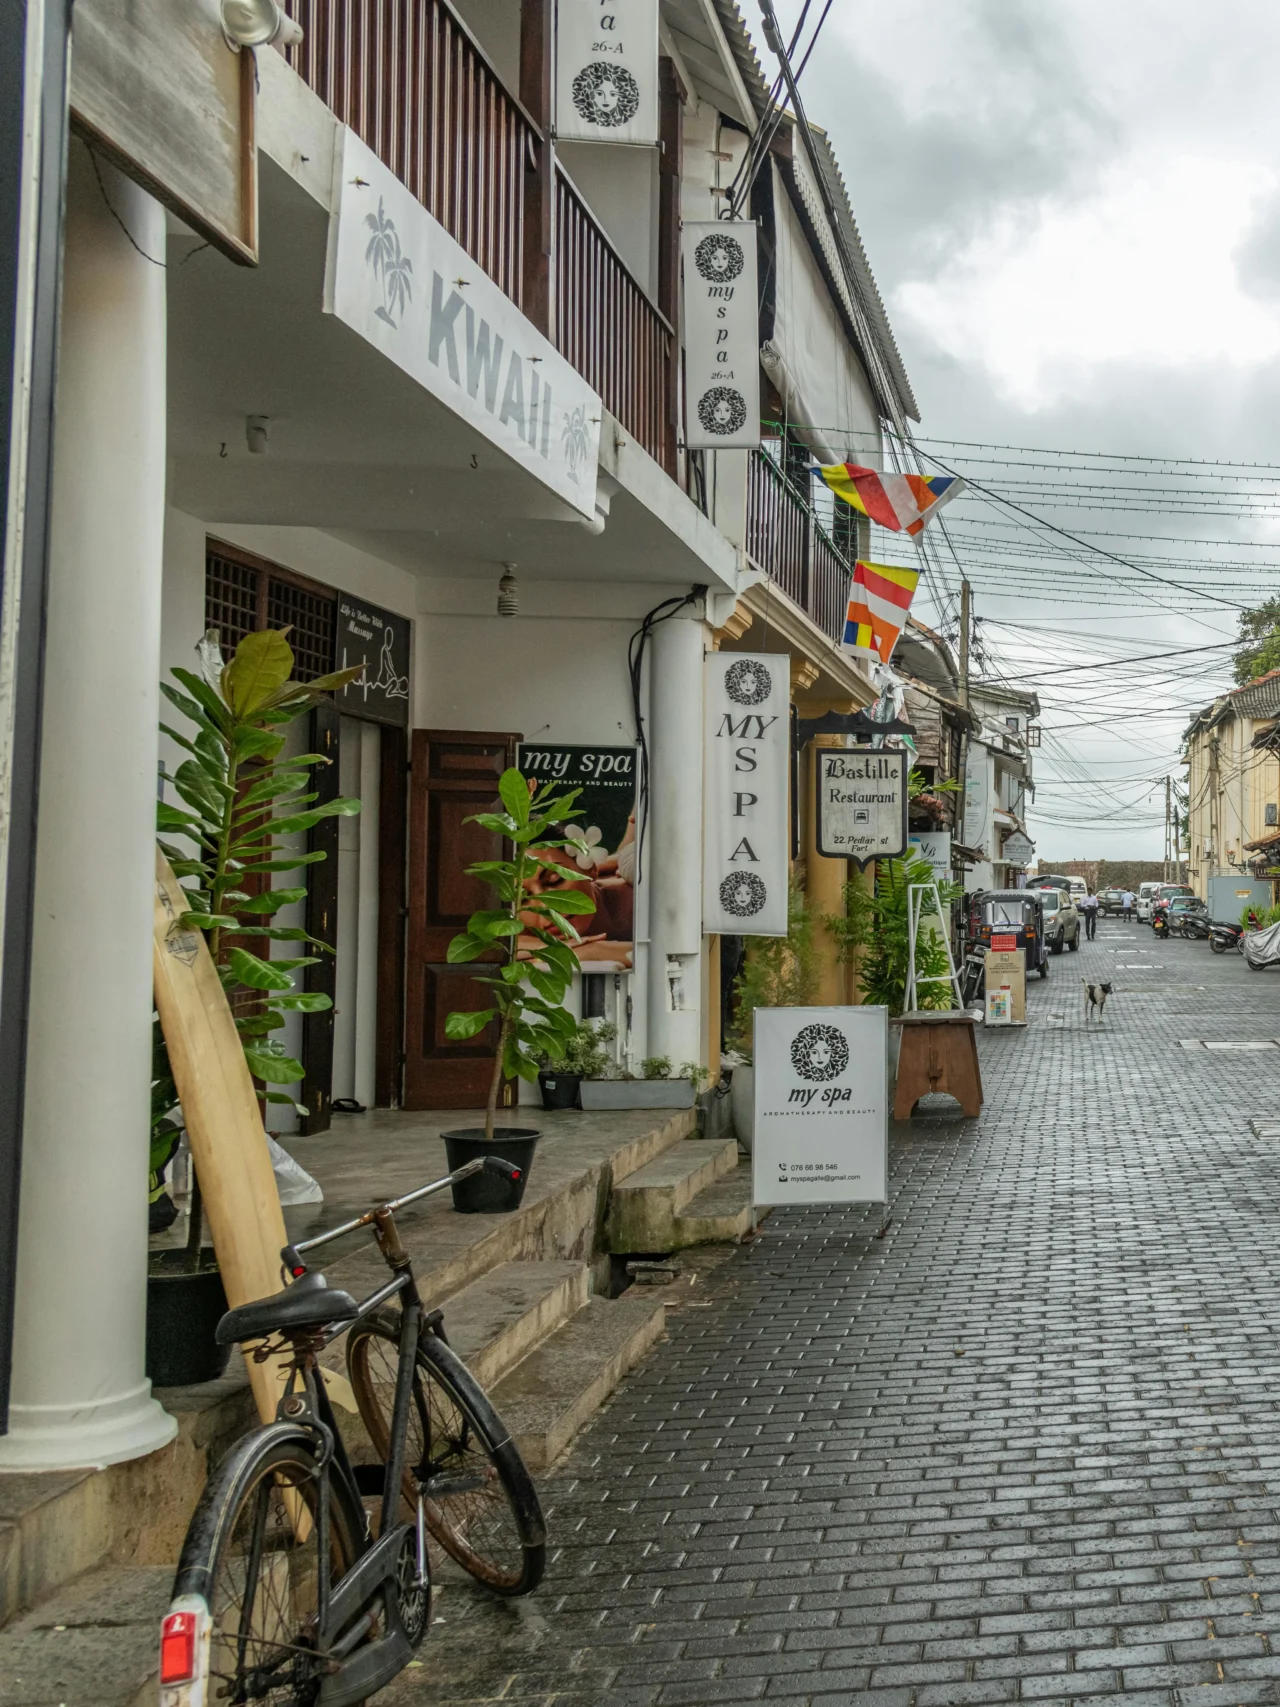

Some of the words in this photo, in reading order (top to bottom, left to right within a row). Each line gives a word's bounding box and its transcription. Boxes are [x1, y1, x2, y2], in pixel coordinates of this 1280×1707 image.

[591, 41, 624, 54] 26-A
[707, 285, 735, 301] my
[710, 371, 735, 380] 26-A
[347, 620, 373, 640] Massage
[715, 713, 779, 740] MY
[523, 751, 572, 777] my
[580, 753, 633, 778] spa
[825, 758, 899, 780] Bastille
[829, 788, 898, 804] Restaurant
[851, 845, 868, 853] Fort
[787, 1088, 819, 1108] my
[821, 1087, 852, 1108] spa
[825, 1163, 838, 1171] 546
